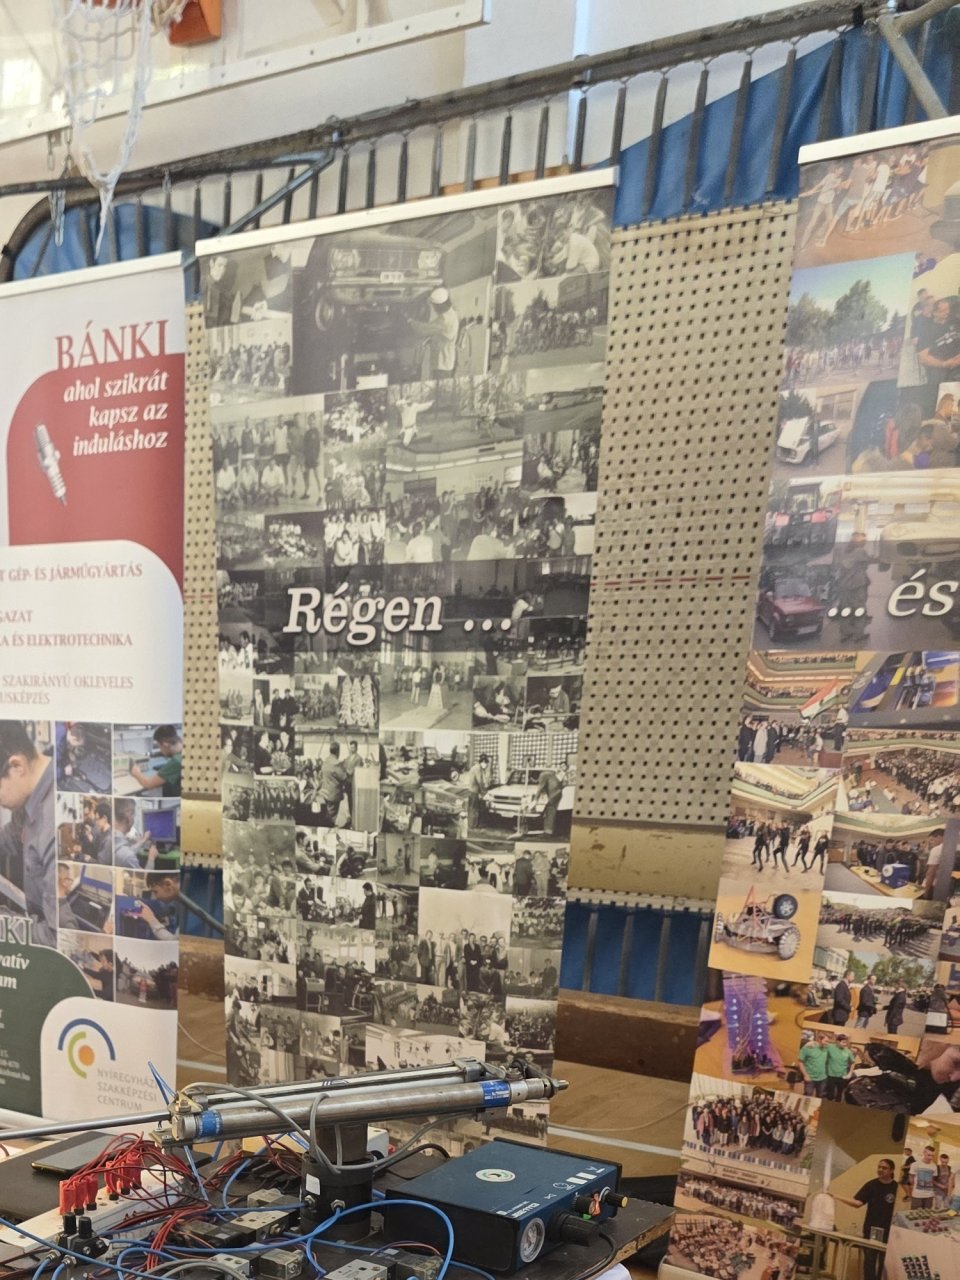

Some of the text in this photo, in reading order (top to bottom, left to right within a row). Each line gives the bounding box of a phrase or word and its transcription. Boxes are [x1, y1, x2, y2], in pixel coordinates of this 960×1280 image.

[55, 320, 169, 370] BÁNKI
[63, 369, 168, 403] ahol szikrát
[89, 403, 168, 429] kapsz az
[73, 428, 169, 456] induláshoz
[35, 564, 48, 582] ÉS
[49, 561, 143, 583] JÁRMŰGYÁRTÁS
[887, 567, 959, 617] és
[283, 582, 443, 646] Régen
[12, 633, 25, 647] ÉS
[26, 633, 133, 648] ELEKTROTECHNIKA
[74, 675, 134, 688] OKLEVELES
[97, 1081, 158, 1102] SZAKKÉPZÉSI
[97, 1094, 143, 1111] CENTRUM
